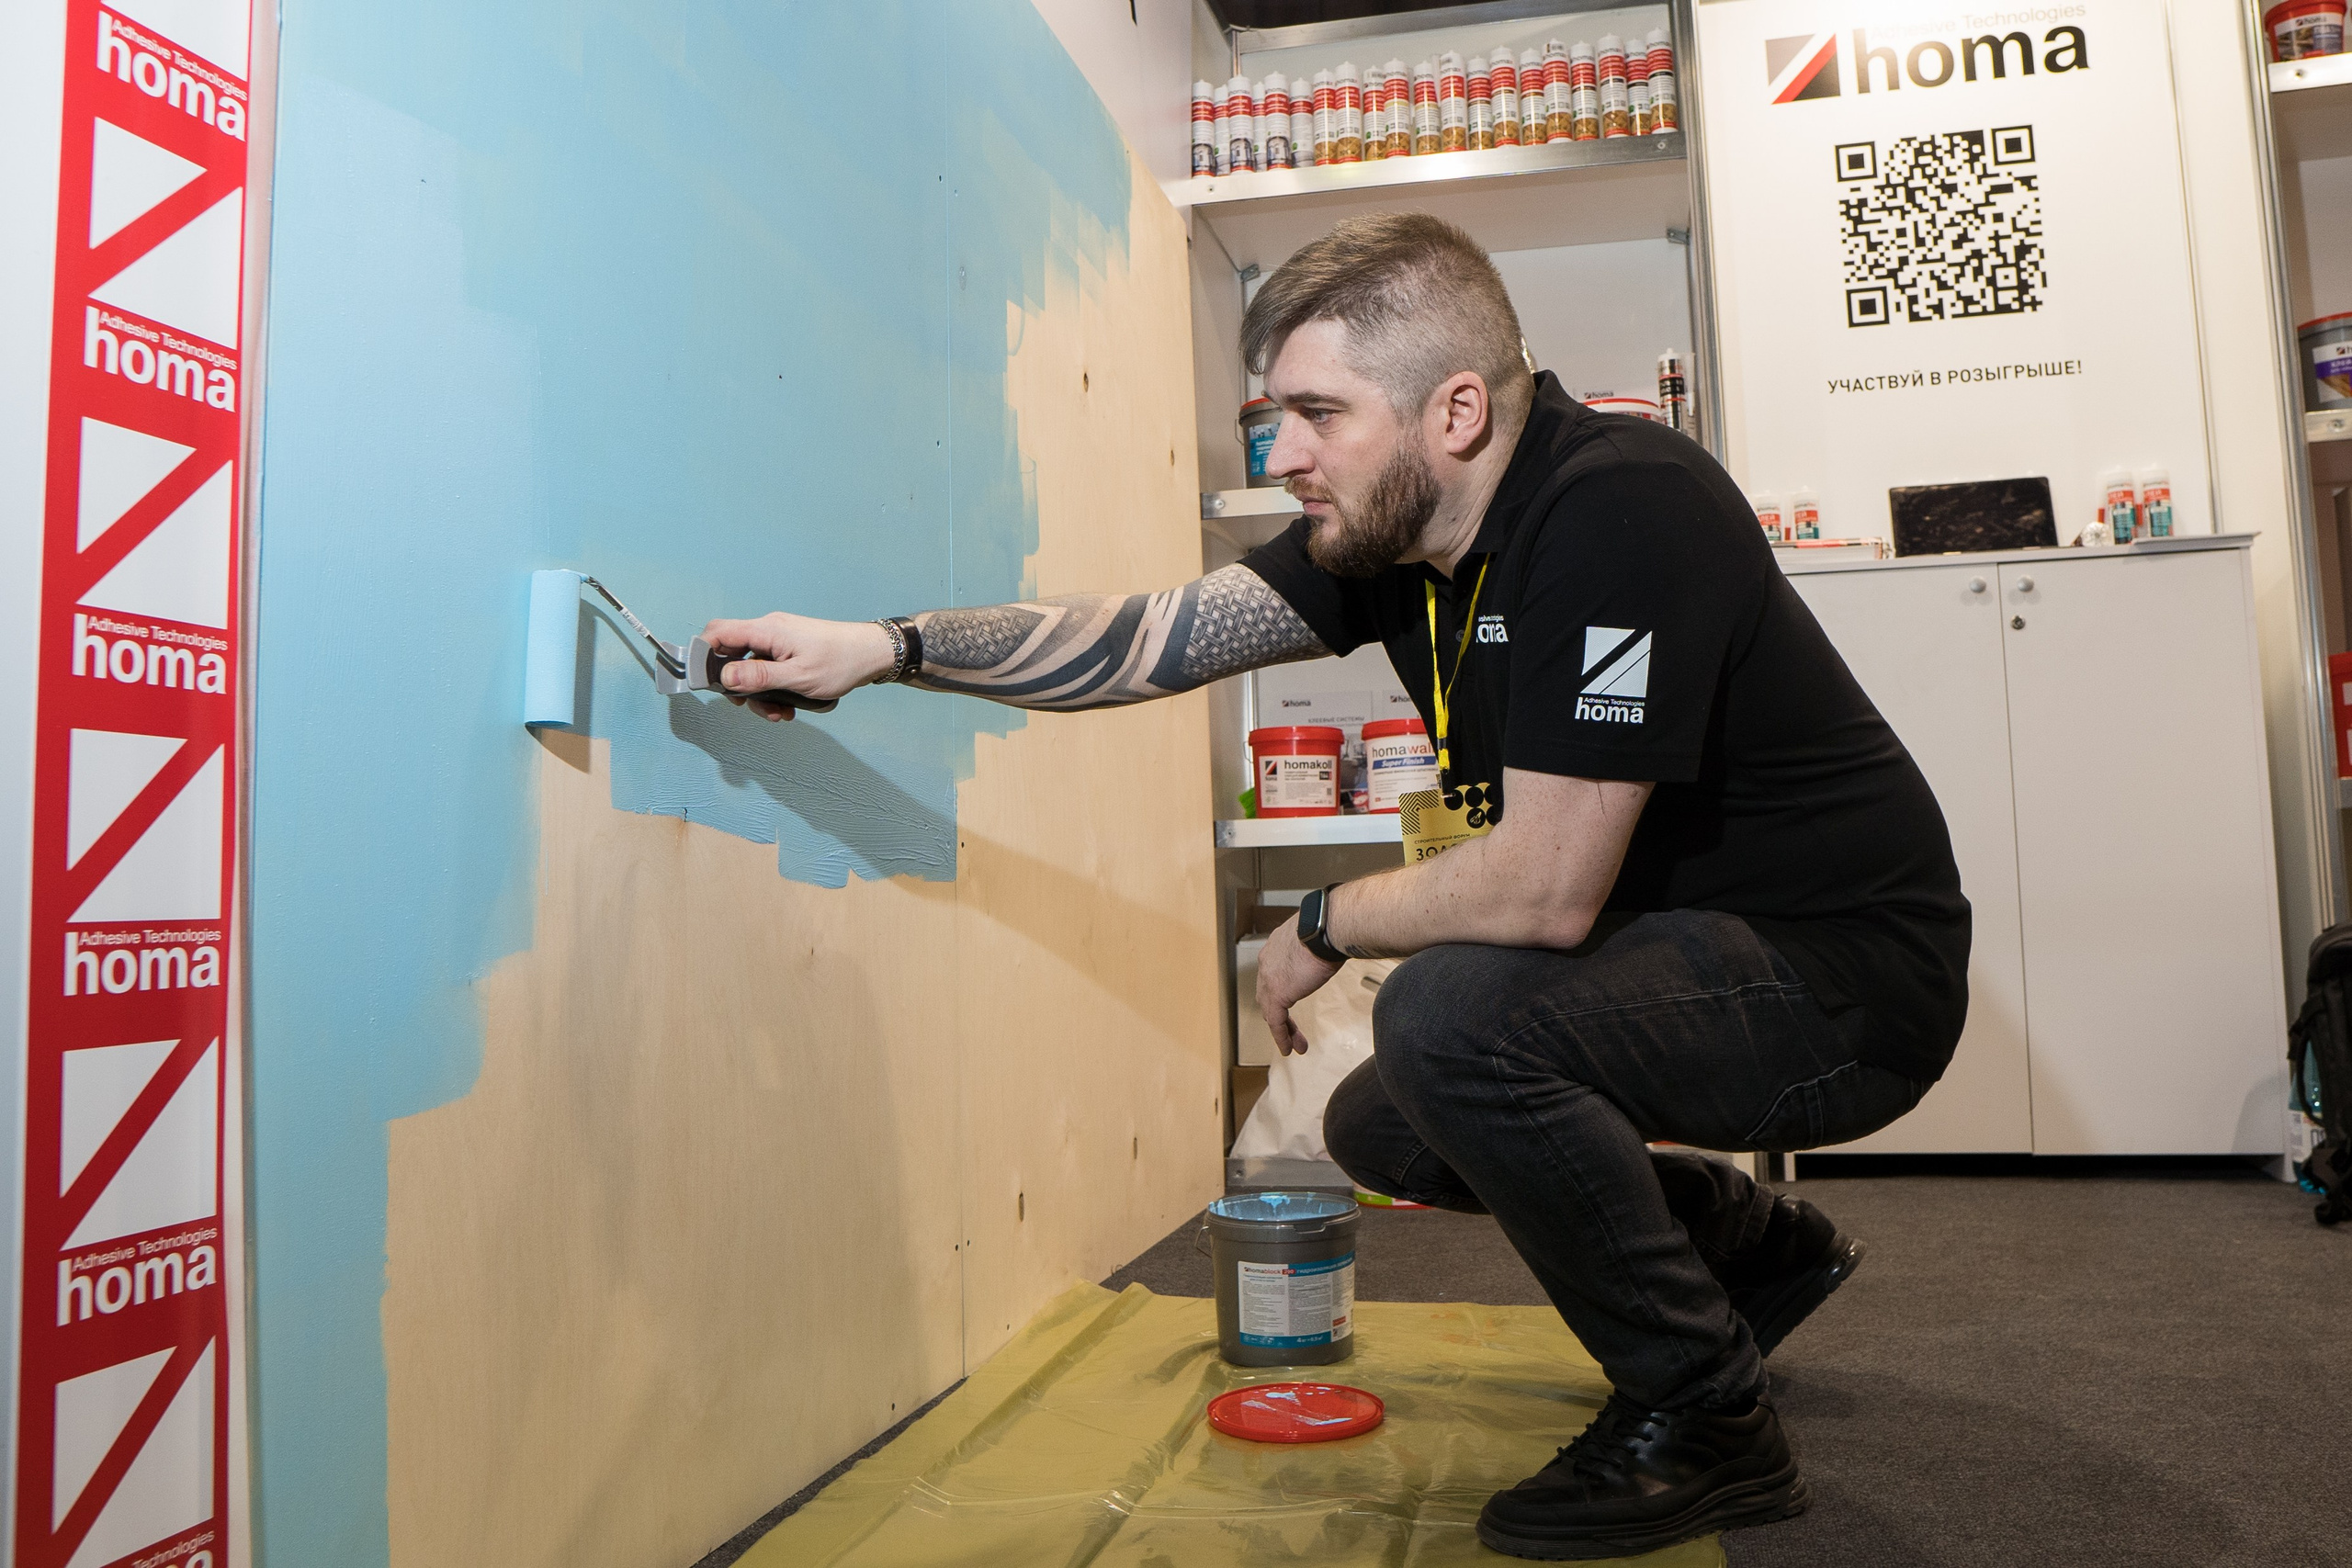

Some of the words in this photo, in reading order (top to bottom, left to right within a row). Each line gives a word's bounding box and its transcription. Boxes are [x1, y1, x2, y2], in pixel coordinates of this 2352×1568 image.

[1962, 4, 2087, 30] Technologies
[96, 9, 246, 142] homa
[111, 18, 171, 61] Adhesive
[172, 50, 248, 101] Technologies
[1852, 25, 2090, 95] homa
[84, 305, 236, 412] homa
[99, 310, 160, 344] Adhesive
[161, 332, 238, 370] Technologies
[1827, 369, 1924, 394] УЧАСТВУЙ
[1930, 371, 1942, 386] В
[1948, 360, 2084, 384] РОЗЫГРЫШЕ!
[86, 615, 150, 638] Adhesive
[150, 626, 228, 650] Technologies
[72, 613, 227, 694] homa
[1290, 699, 1311, 707] homa
[1574, 696, 1644, 724] homa
[1611, 699, 1645, 707] Technologies
[1283, 760, 1332, 770] homakoll
[1381, 760, 1402, 768] Super
[78, 931, 141, 946] Adhesive
[142, 928, 221, 944] Technologies
[63, 931, 220, 997] homa
[72, 1247, 136, 1272] Adhesive
[137, 1227, 218, 1256] Technologies
[56, 1245, 217, 1327] homa
